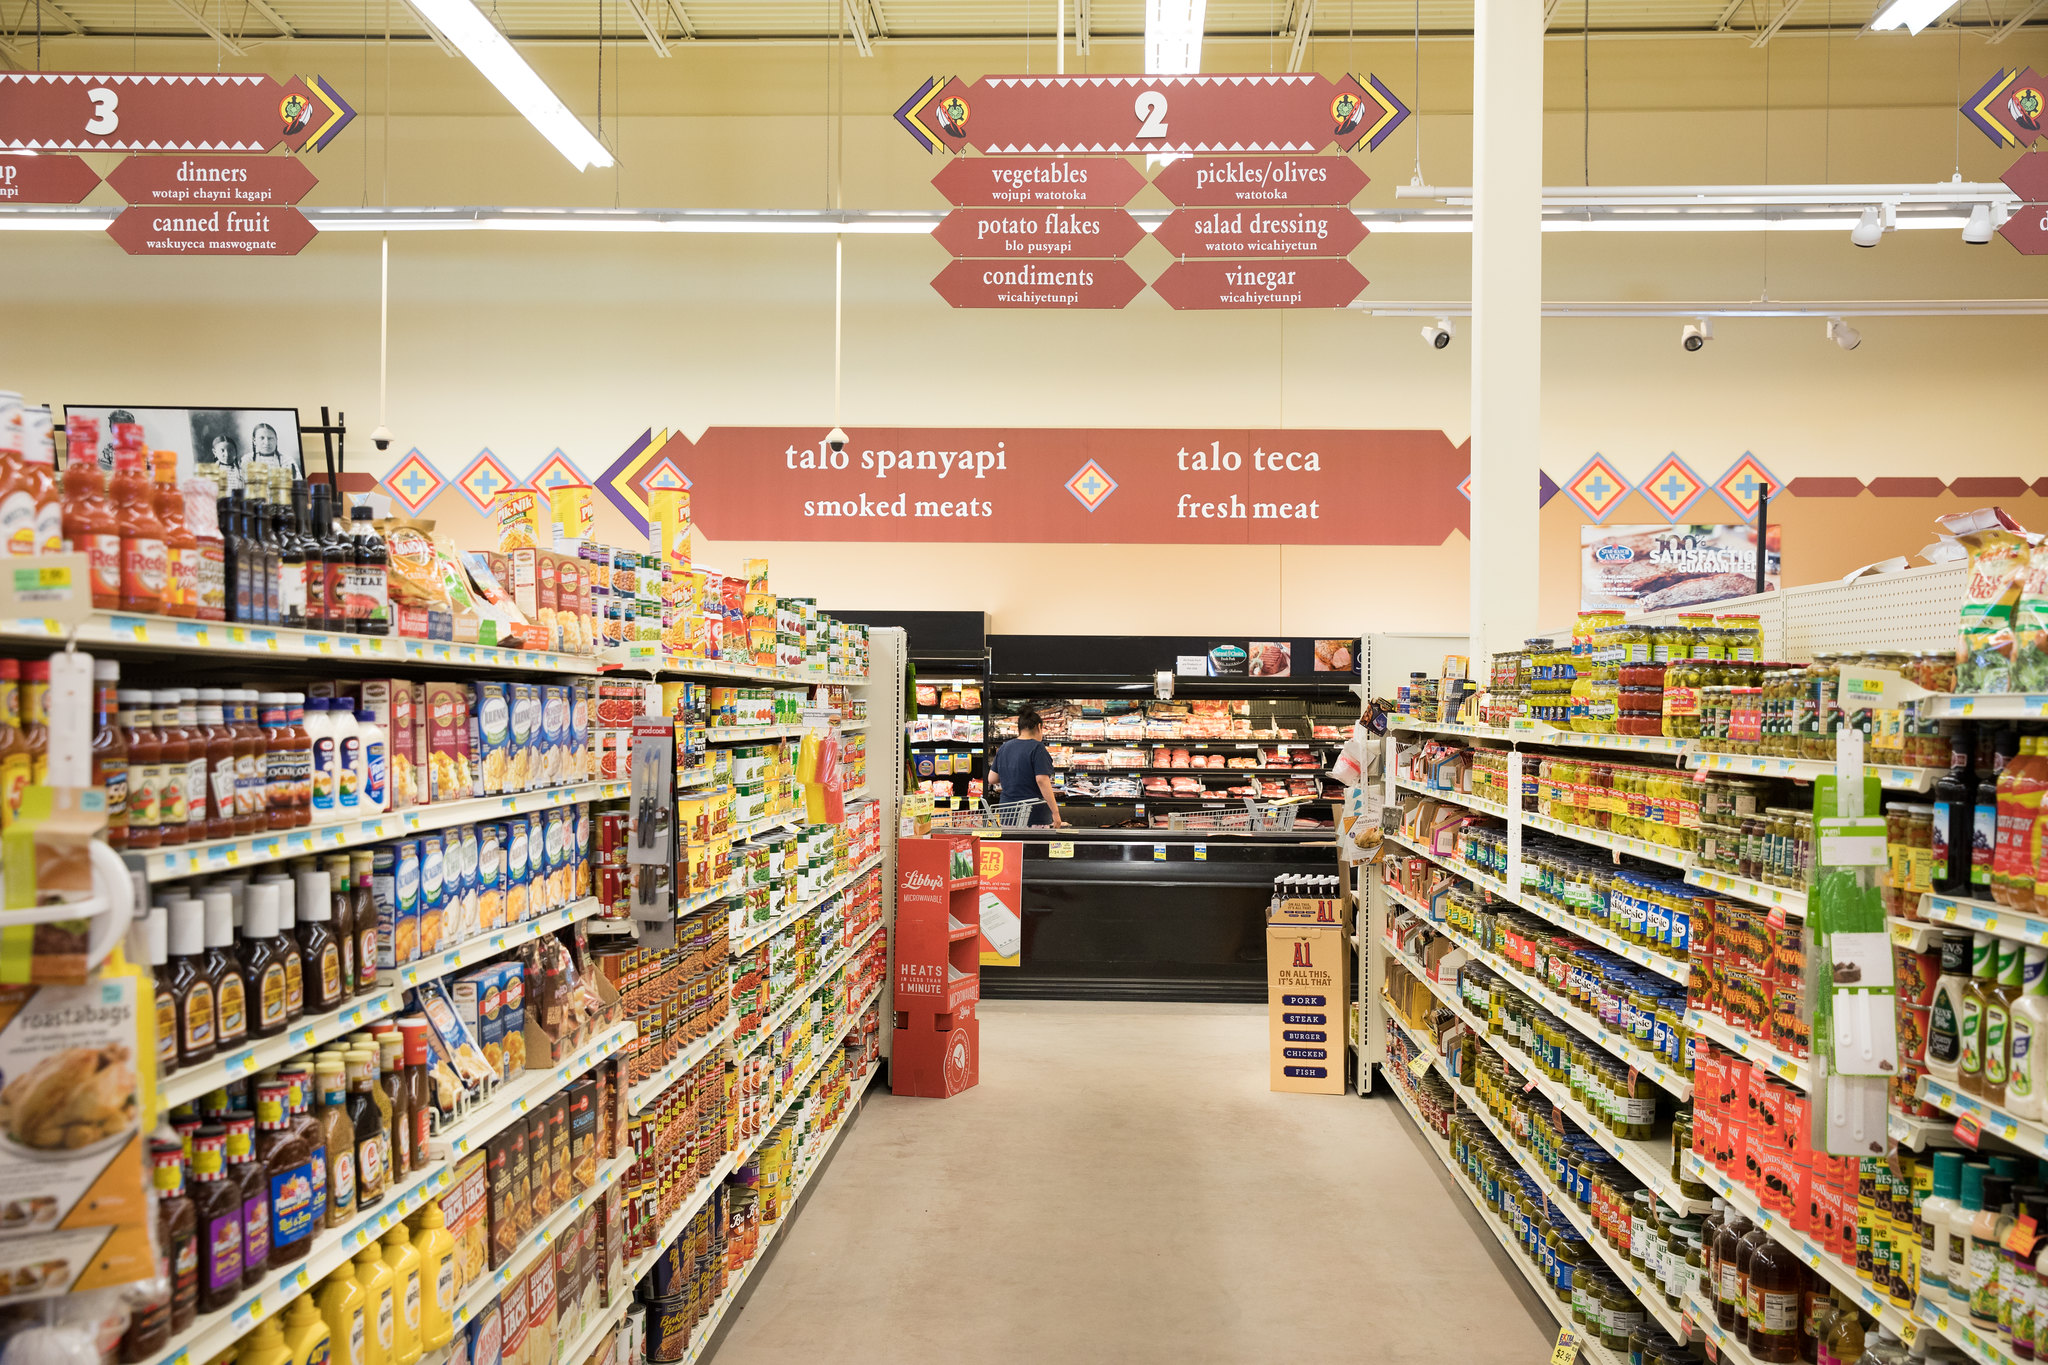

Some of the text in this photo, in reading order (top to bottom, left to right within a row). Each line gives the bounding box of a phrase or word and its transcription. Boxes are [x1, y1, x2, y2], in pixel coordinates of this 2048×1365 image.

[85, 88, 119, 135] 3
[1134, 91, 1168, 138] 2
[177, 161, 247, 182] dinners
[992, 162, 1088, 187] vegetables
[1197, 163, 1327, 188] pickles/olives
[152, 188, 189, 201] wotapi
[235, 188, 272, 201] kagapi
[992, 190, 1087, 202] wojupi watotoka
[1235, 190, 1288, 200] watotoka
[152, 211, 270, 232] canned fruit
[977, 213, 1100, 239] potato flakes
[1195, 214, 1328, 239] salad dressing
[147, 238, 276, 251] waskuyeca maswognate
[1005, 241, 1072, 255] blo pusyapi
[1205, 240, 1317, 253] watoto wicahiyetun
[983, 265, 1094, 286] condiments
[1225, 265, 1296, 290] vinegar
[997, 291, 1079, 304] wicahiyetunpi
[1220, 291, 1302, 304] wicahiyetunpi
[785, 441, 1007, 478] talo spanyapi
[1176, 441, 1321, 471] talo teca
[803, 493, 993, 518] smoked meats
[1176, 495, 1320, 519] fresh meat
[1655, 534, 1706, 550] 100%
[1649, 549, 1773, 565] SATISFACTIO.
[901, 870, 943, 890] Libby's
[904, 894, 942, 904] MICROWAVABLE
[1316, 900, 1335, 923] A1
[1293, 942, 1313, 968] A1
[901, 964, 942, 977] HEATS
[1279, 970, 1291, 979] ON
[1293, 970, 1307, 979] ALL
[900, 982, 942, 994] 1 MINUTE
[1278, 978, 1332, 987] IT'S ALL THAT
[1290, 997, 1318, 1005] PORK
[1289, 1015, 1319, 1023] STEAK
[1289, 1033, 1321, 1041] BURGER
[1286, 1050, 1325, 1058] CHICKEN
[530, 1269, 555, 1315] JACK
[503, 1296, 528, 1344] JACK
[1555, 1349, 1571, 1363] $2.99
